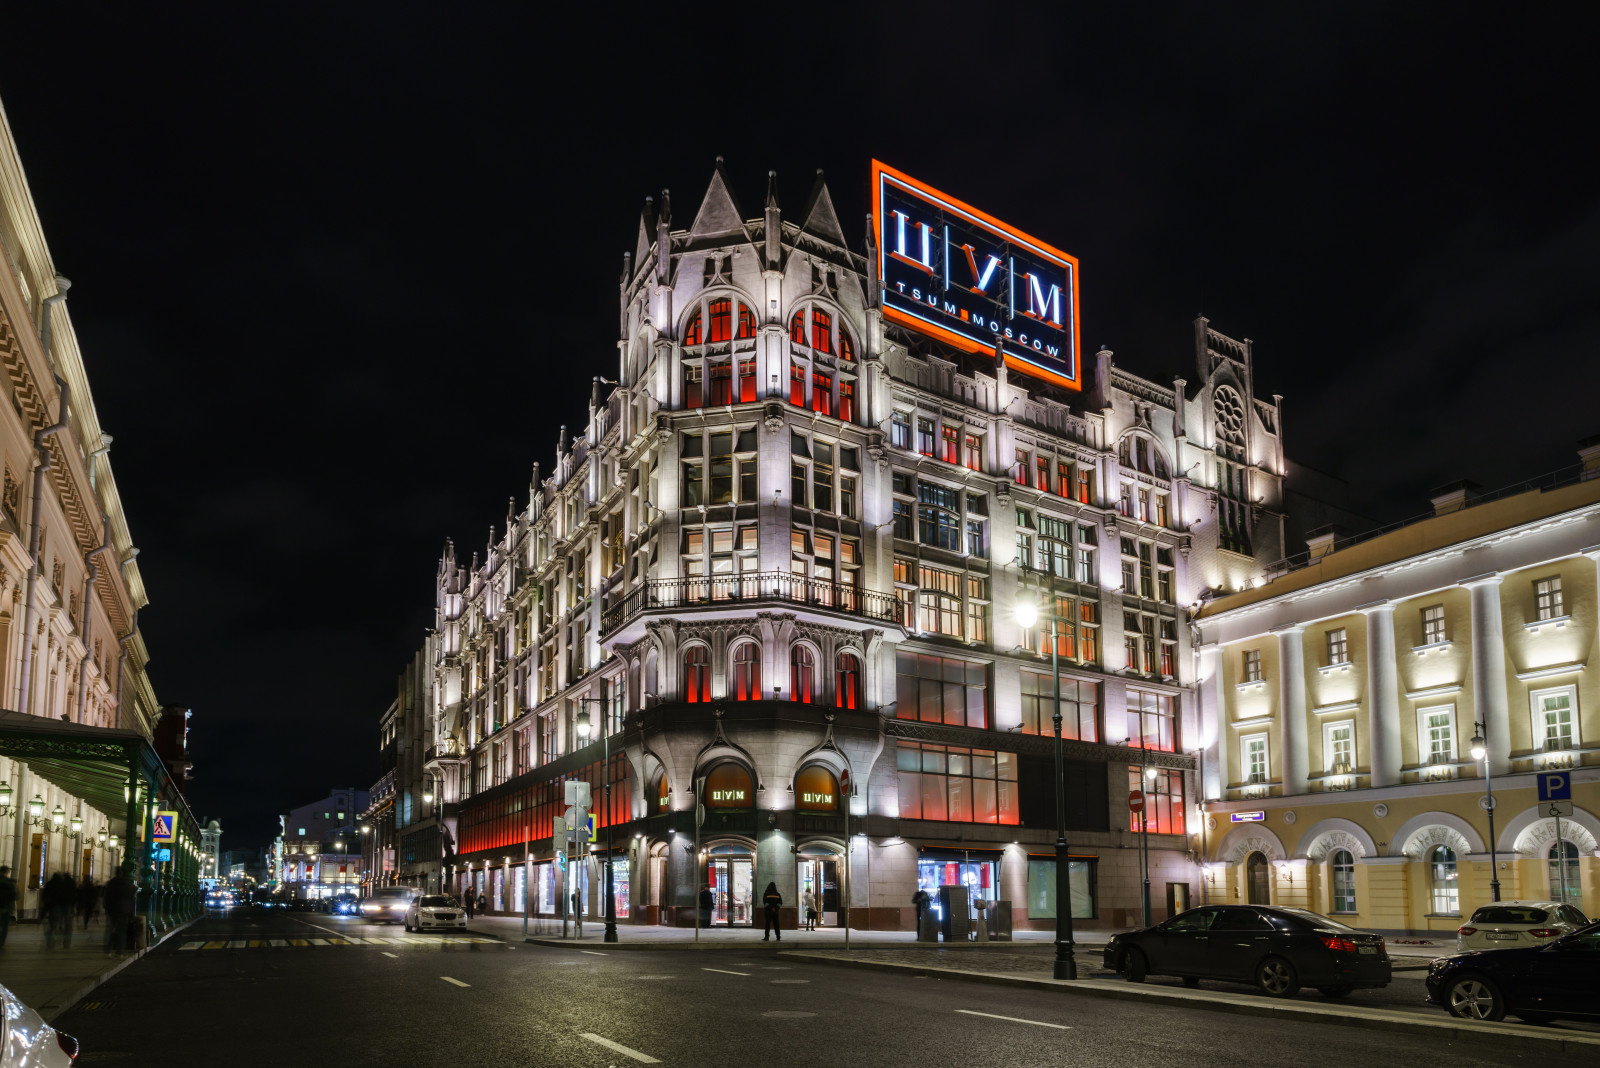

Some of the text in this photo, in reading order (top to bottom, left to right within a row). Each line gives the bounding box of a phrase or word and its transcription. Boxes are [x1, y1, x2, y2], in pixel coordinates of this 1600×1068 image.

[896, 281, 1059, 357] TSUM MOSCOW
[1546, 775, 1565, 799] P
